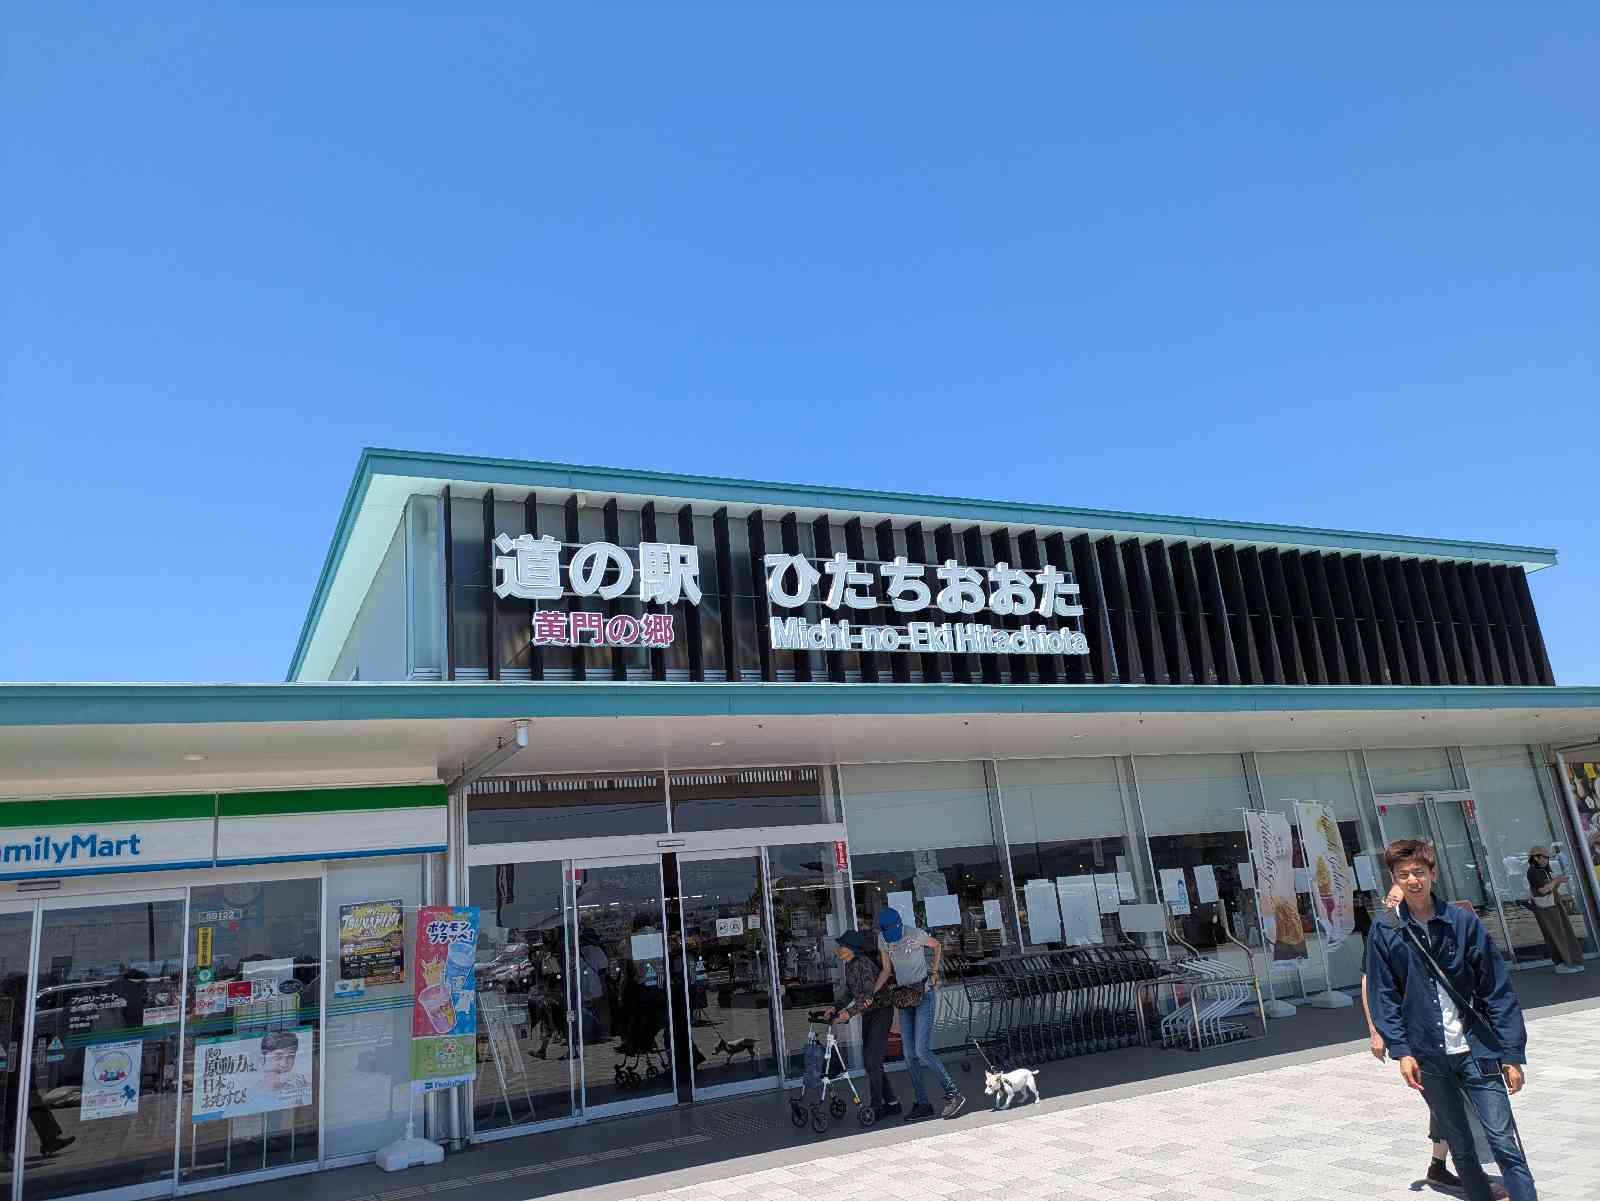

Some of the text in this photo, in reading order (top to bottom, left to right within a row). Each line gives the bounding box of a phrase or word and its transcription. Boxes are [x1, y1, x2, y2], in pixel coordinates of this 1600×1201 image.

[494, 532, 1084, 618] 道の駅 ひたちおおた
[532, 610, 675, 648] 黄門の郷
[770, 616, 1090, 655] Michi-no-Eki Hitachiota
[0, 833, 141, 863] milyMart
[427, 920, 471, 934] ポケモン
